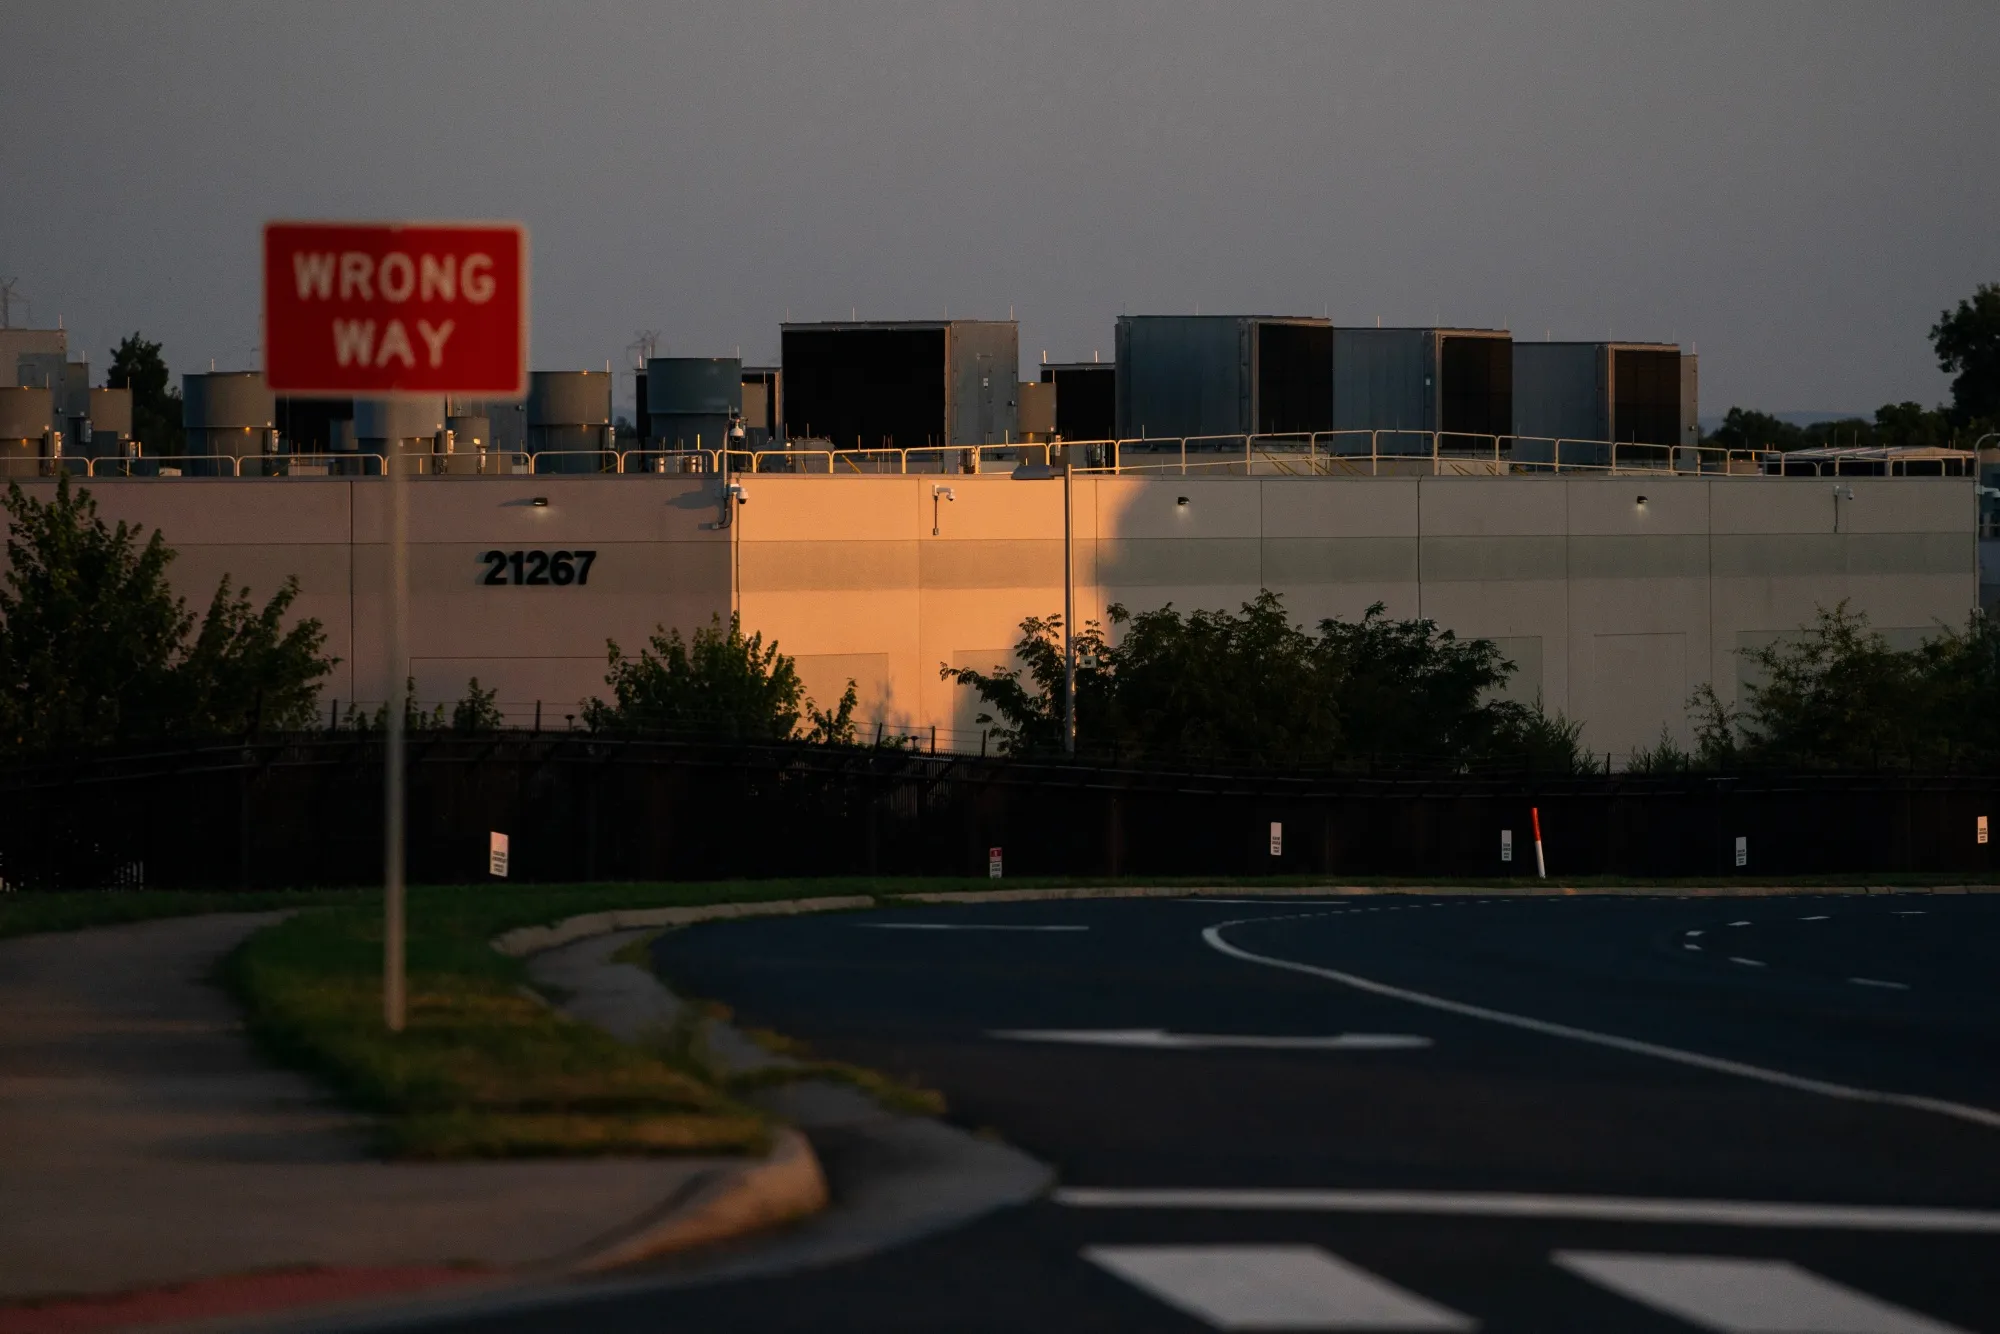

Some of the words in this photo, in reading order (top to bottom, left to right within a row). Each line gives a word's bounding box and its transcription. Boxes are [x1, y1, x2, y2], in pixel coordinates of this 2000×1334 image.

[293, 251, 496, 303] WRONG
[332, 318, 456, 368] WAY
[483, 550, 597, 586] 21267
